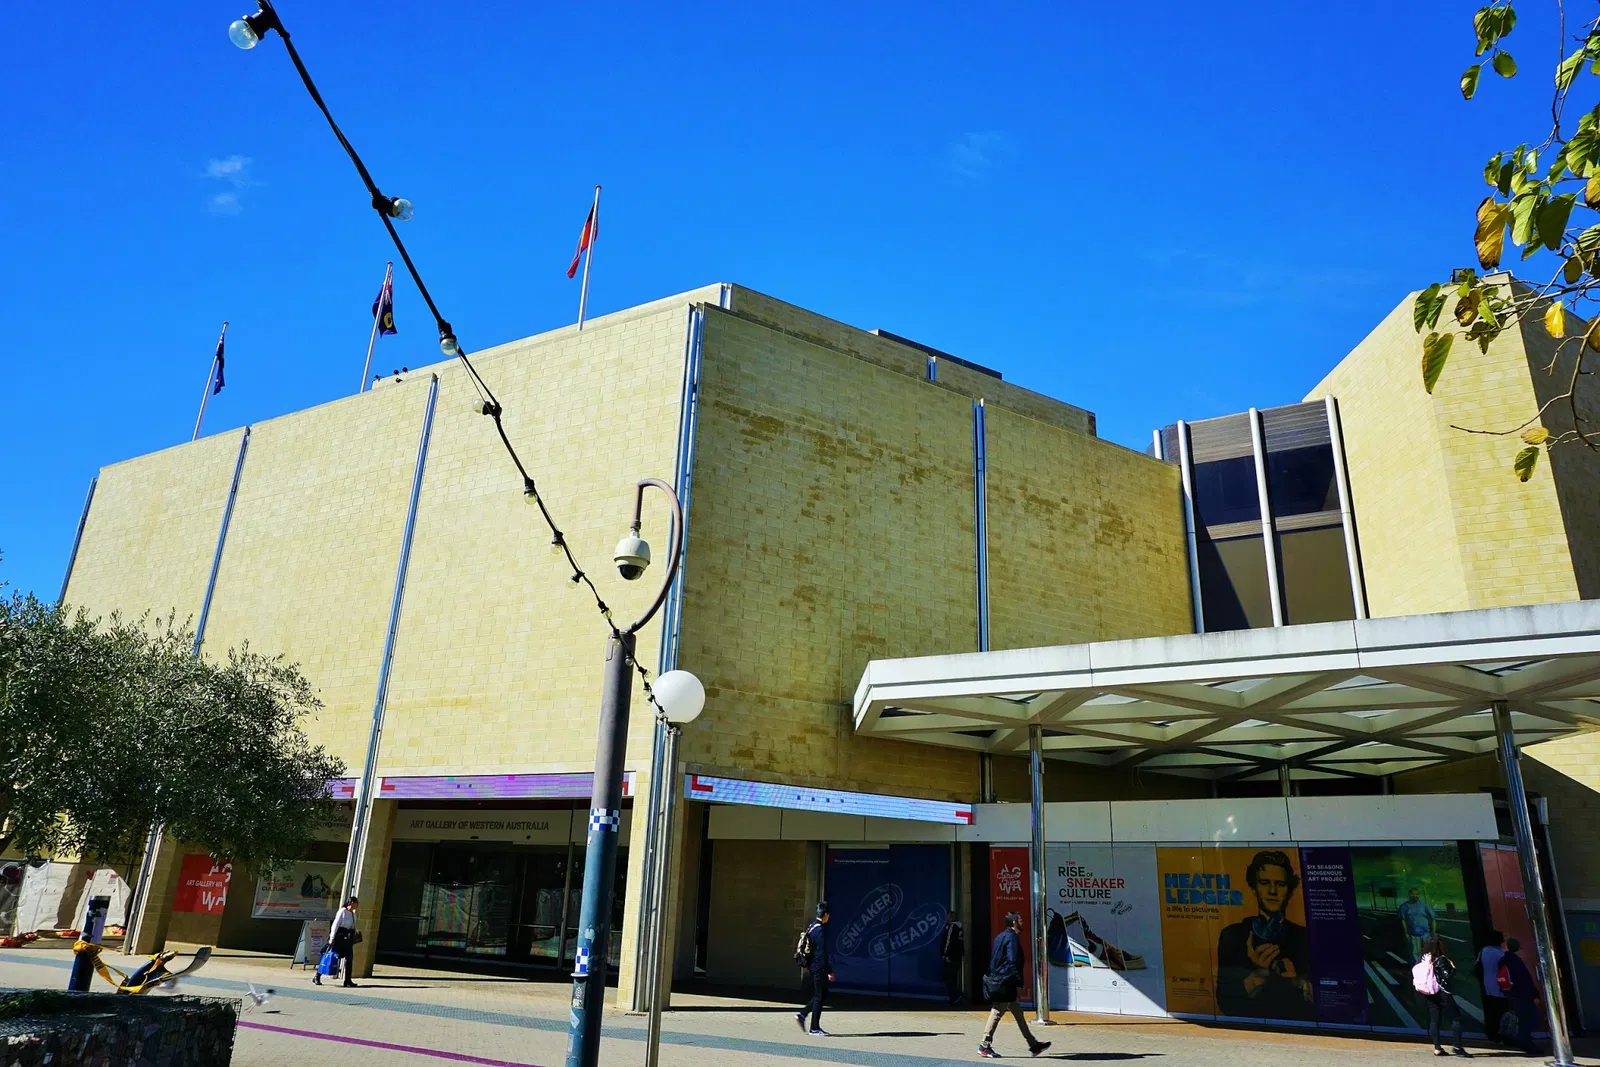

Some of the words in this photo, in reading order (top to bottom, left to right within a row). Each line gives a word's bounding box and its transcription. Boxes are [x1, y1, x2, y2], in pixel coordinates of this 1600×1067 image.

[409, 820, 424, 829] ART
[426, 820, 458, 830] GALLERY
[458, 821, 469, 830] OF
[470, 821, 505, 831] WESTERN
[505, 821, 550, 831] AUSTRALIA
[1058, 866, 1086, 877] RISE
[195, 880, 215, 888] GALLERY
[1066, 878, 1125, 889] SNEAKER
[1164, 873, 1230, 889] HEATH
[202, 887, 228, 911] WA
[1059, 889, 1111, 899] CULTURE
[1165, 889, 1244, 906] LEDGER
[1191, 906, 1219, 914] pictures
[842, 893, 894, 949] SNEAKER
[890, 912, 938, 951] HEADS
